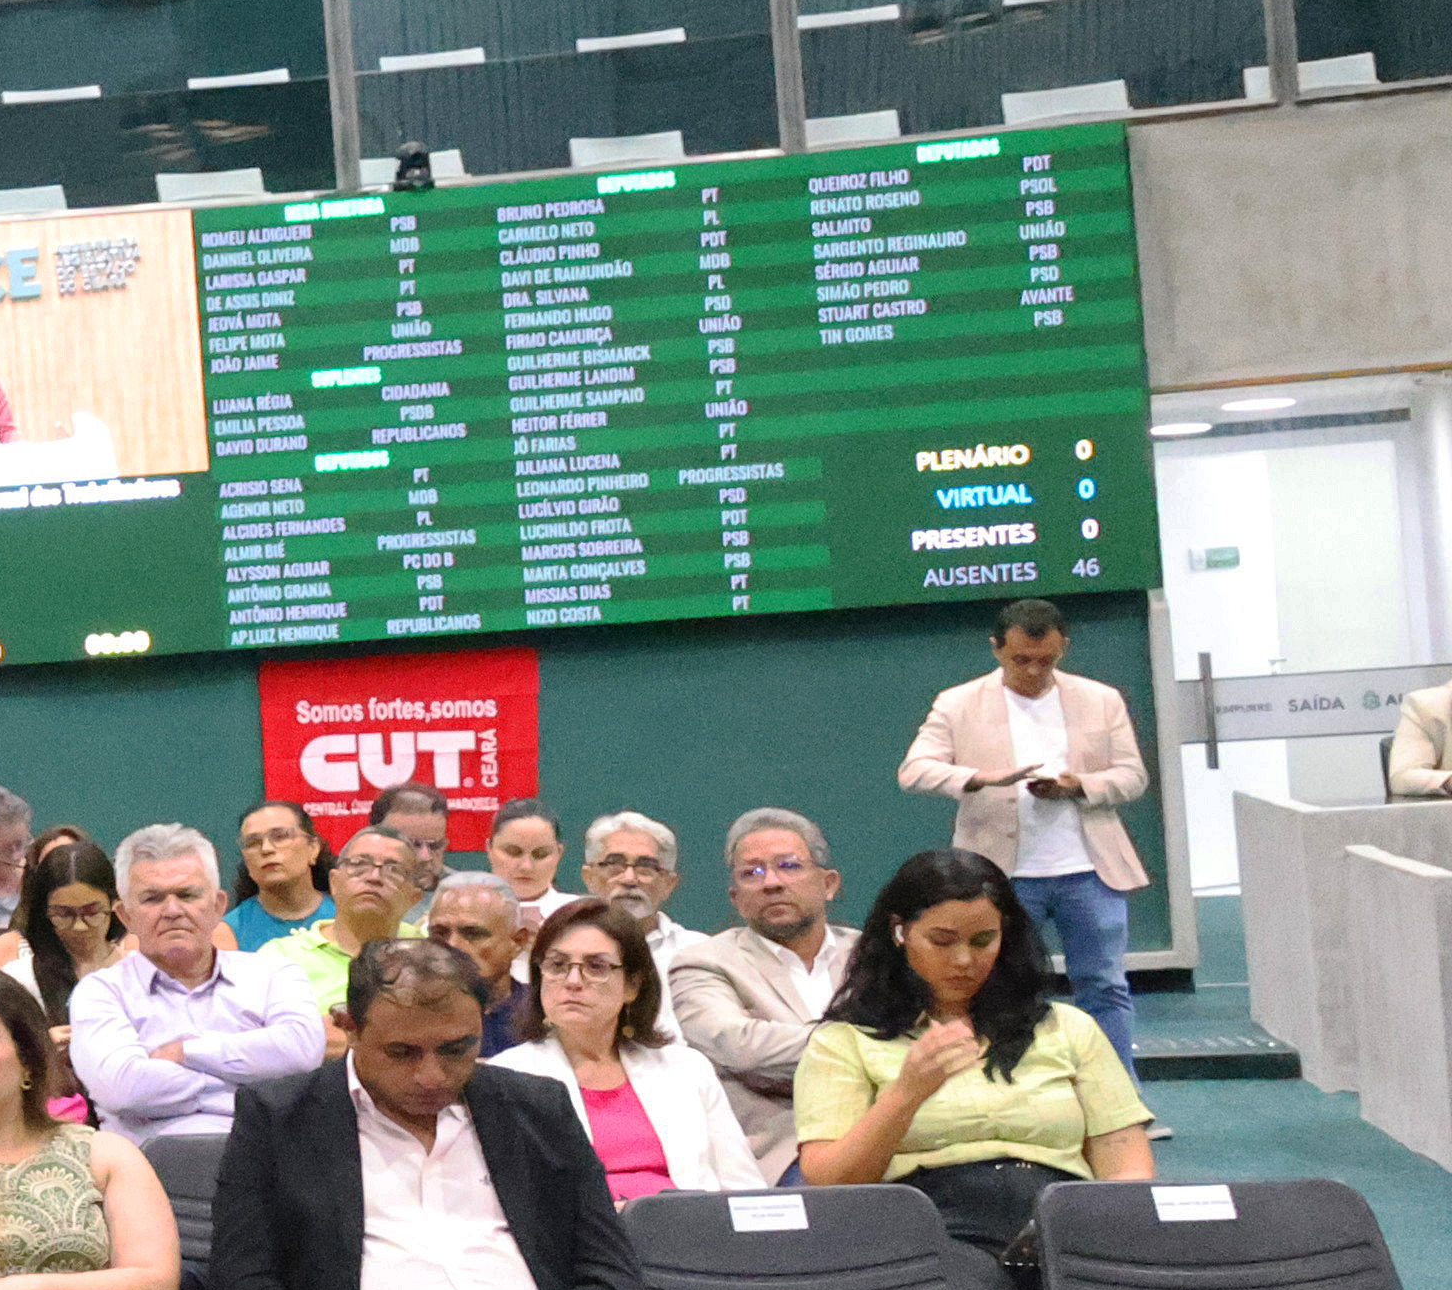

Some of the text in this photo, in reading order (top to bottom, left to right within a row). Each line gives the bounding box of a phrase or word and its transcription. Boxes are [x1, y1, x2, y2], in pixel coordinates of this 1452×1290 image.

[1023, 155, 1052, 172] PDT
[809, 169, 910, 194] QUEIROZ FILHO
[1020, 177, 1058, 195] PSOL
[701, 188, 718, 203] PT
[810, 190, 921, 215] RENATO ROSENO
[497, 199, 605, 223] BRUNO PEDROSA
[703, 210, 720, 225] PL
[1025, 200, 1055, 216] PSB
[390, 216, 416, 232] PSB
[498, 221, 595, 245] CARMELO NETO
[812, 217, 872, 237] SALMITO
[1019, 220, 1066, 240] UNIÃO
[701, 231, 727, 247] PDT
[814, 230, 967, 259] SARGENTO REGINAURO
[257, 246, 313, 265] OLIVEIRA
[499, 243, 600, 266] CLÁUDIO PINHO
[700, 253, 731, 270] MDB
[1029, 244, 1059, 261] PSB
[399, 259, 415, 274] PT
[502, 260, 633, 288] DAVI DE RAIMUNDÃO
[815, 257, 921, 281] SÉRGIO AGUIAR
[205, 268, 307, 290] LARISSA GASPAR
[400, 280, 416, 295] PT
[708, 274, 725, 290] PL
[536, 287, 589, 305] SILVANA
[817, 279, 910, 302] SIMÃO PEDRO
[1020, 286, 1075, 306] AVANTE
[206, 293, 259, 312] DE ASSIS
[818, 299, 928, 323] STUART CASTRO
[246, 313, 282, 329] MOTA
[504, 305, 613, 329] FERNANDO HUGO
[699, 314, 742, 334] UNIÃO
[1034, 310, 1064, 327] PSB
[209, 333, 285, 353] FELIPE MOTA
[506, 327, 613, 350] FIRMO CAMURÇA
[819, 324, 894, 345] TIN GOMES
[363, 340, 463, 360] PROGRESSISTAS
[708, 338, 734, 354] PSB
[244, 354, 280, 370] JAIME
[507, 345, 651, 372] GUILHERME BISMARCK
[709, 358, 736, 374] PSB
[509, 367, 636, 391] GUILHERME LANDIM
[716, 380, 733, 396] PT
[382, 382, 451, 400] CIDADANIA
[510, 387, 644, 413] GUILHERME SAMPAIO
[213, 397, 254, 414] LUANA
[706, 399, 748, 418] UNIÃO
[512, 411, 608, 434] HEITOR FÉRRER
[719, 423, 736, 438] PT
[371, 423, 468, 444] REPUBLICANOS
[216, 439, 253, 457] DAVID
[531, 436, 577, 452] FARIAS
[721, 445, 738, 460] PT
[516, 454, 621, 476] JULIANA LUCENA
[916, 439, 1094, 472] PLENÁRIO 0
[413, 468, 430, 484] PT
[679, 463, 785, 485] PROGRESSISTAS
[517, 473, 649, 498] LEONARDO PINHEIRO
[936, 477, 1097, 509] VIRTUAL 0
[221, 499, 305, 519] AGENOR NETO
[519, 495, 620, 519] LUCÍLVIO GIRÃO
[721, 509, 748, 525] PDT
[417, 511, 433, 526] PL
[520, 517, 632, 540] LUCINILDO FROTA
[223, 517, 346, 541] ALCIDES FERNANDES
[723, 531, 751, 547] PSB
[911, 518, 1100, 551] PRESENTES 0
[377, 529, 477, 550] PROGRESSISTAS
[224, 546, 262, 562] ALMIR
[521, 539, 643, 561] MARCOS SOBREIRA
[724, 552, 751, 569] PSB
[226, 561, 331, 582] ALYSSON AGUIAR
[523, 560, 646, 583] MARTA GONÇALVES
[923, 558, 1101, 588] AUSENTES 46
[417, 574, 443, 590] PSB
[731, 574, 749, 590] PT
[525, 584, 611, 604] MISSIAS DIAS
[733, 595, 750, 611] PT
[230, 602, 348, 625] ANTÔNIO HENRIQUE
[527, 606, 602, 625] NIZO COSTA
[278, 624, 340, 641] HENRIQUE
[387, 614, 482, 634] REPUBLICANOS
[296, 699, 364, 723] Somos
[1288, 694, 1345, 712] SAÍDA
[300, 730, 476, 792] CUT
[478, 728, 498, 787] CEARÁ
